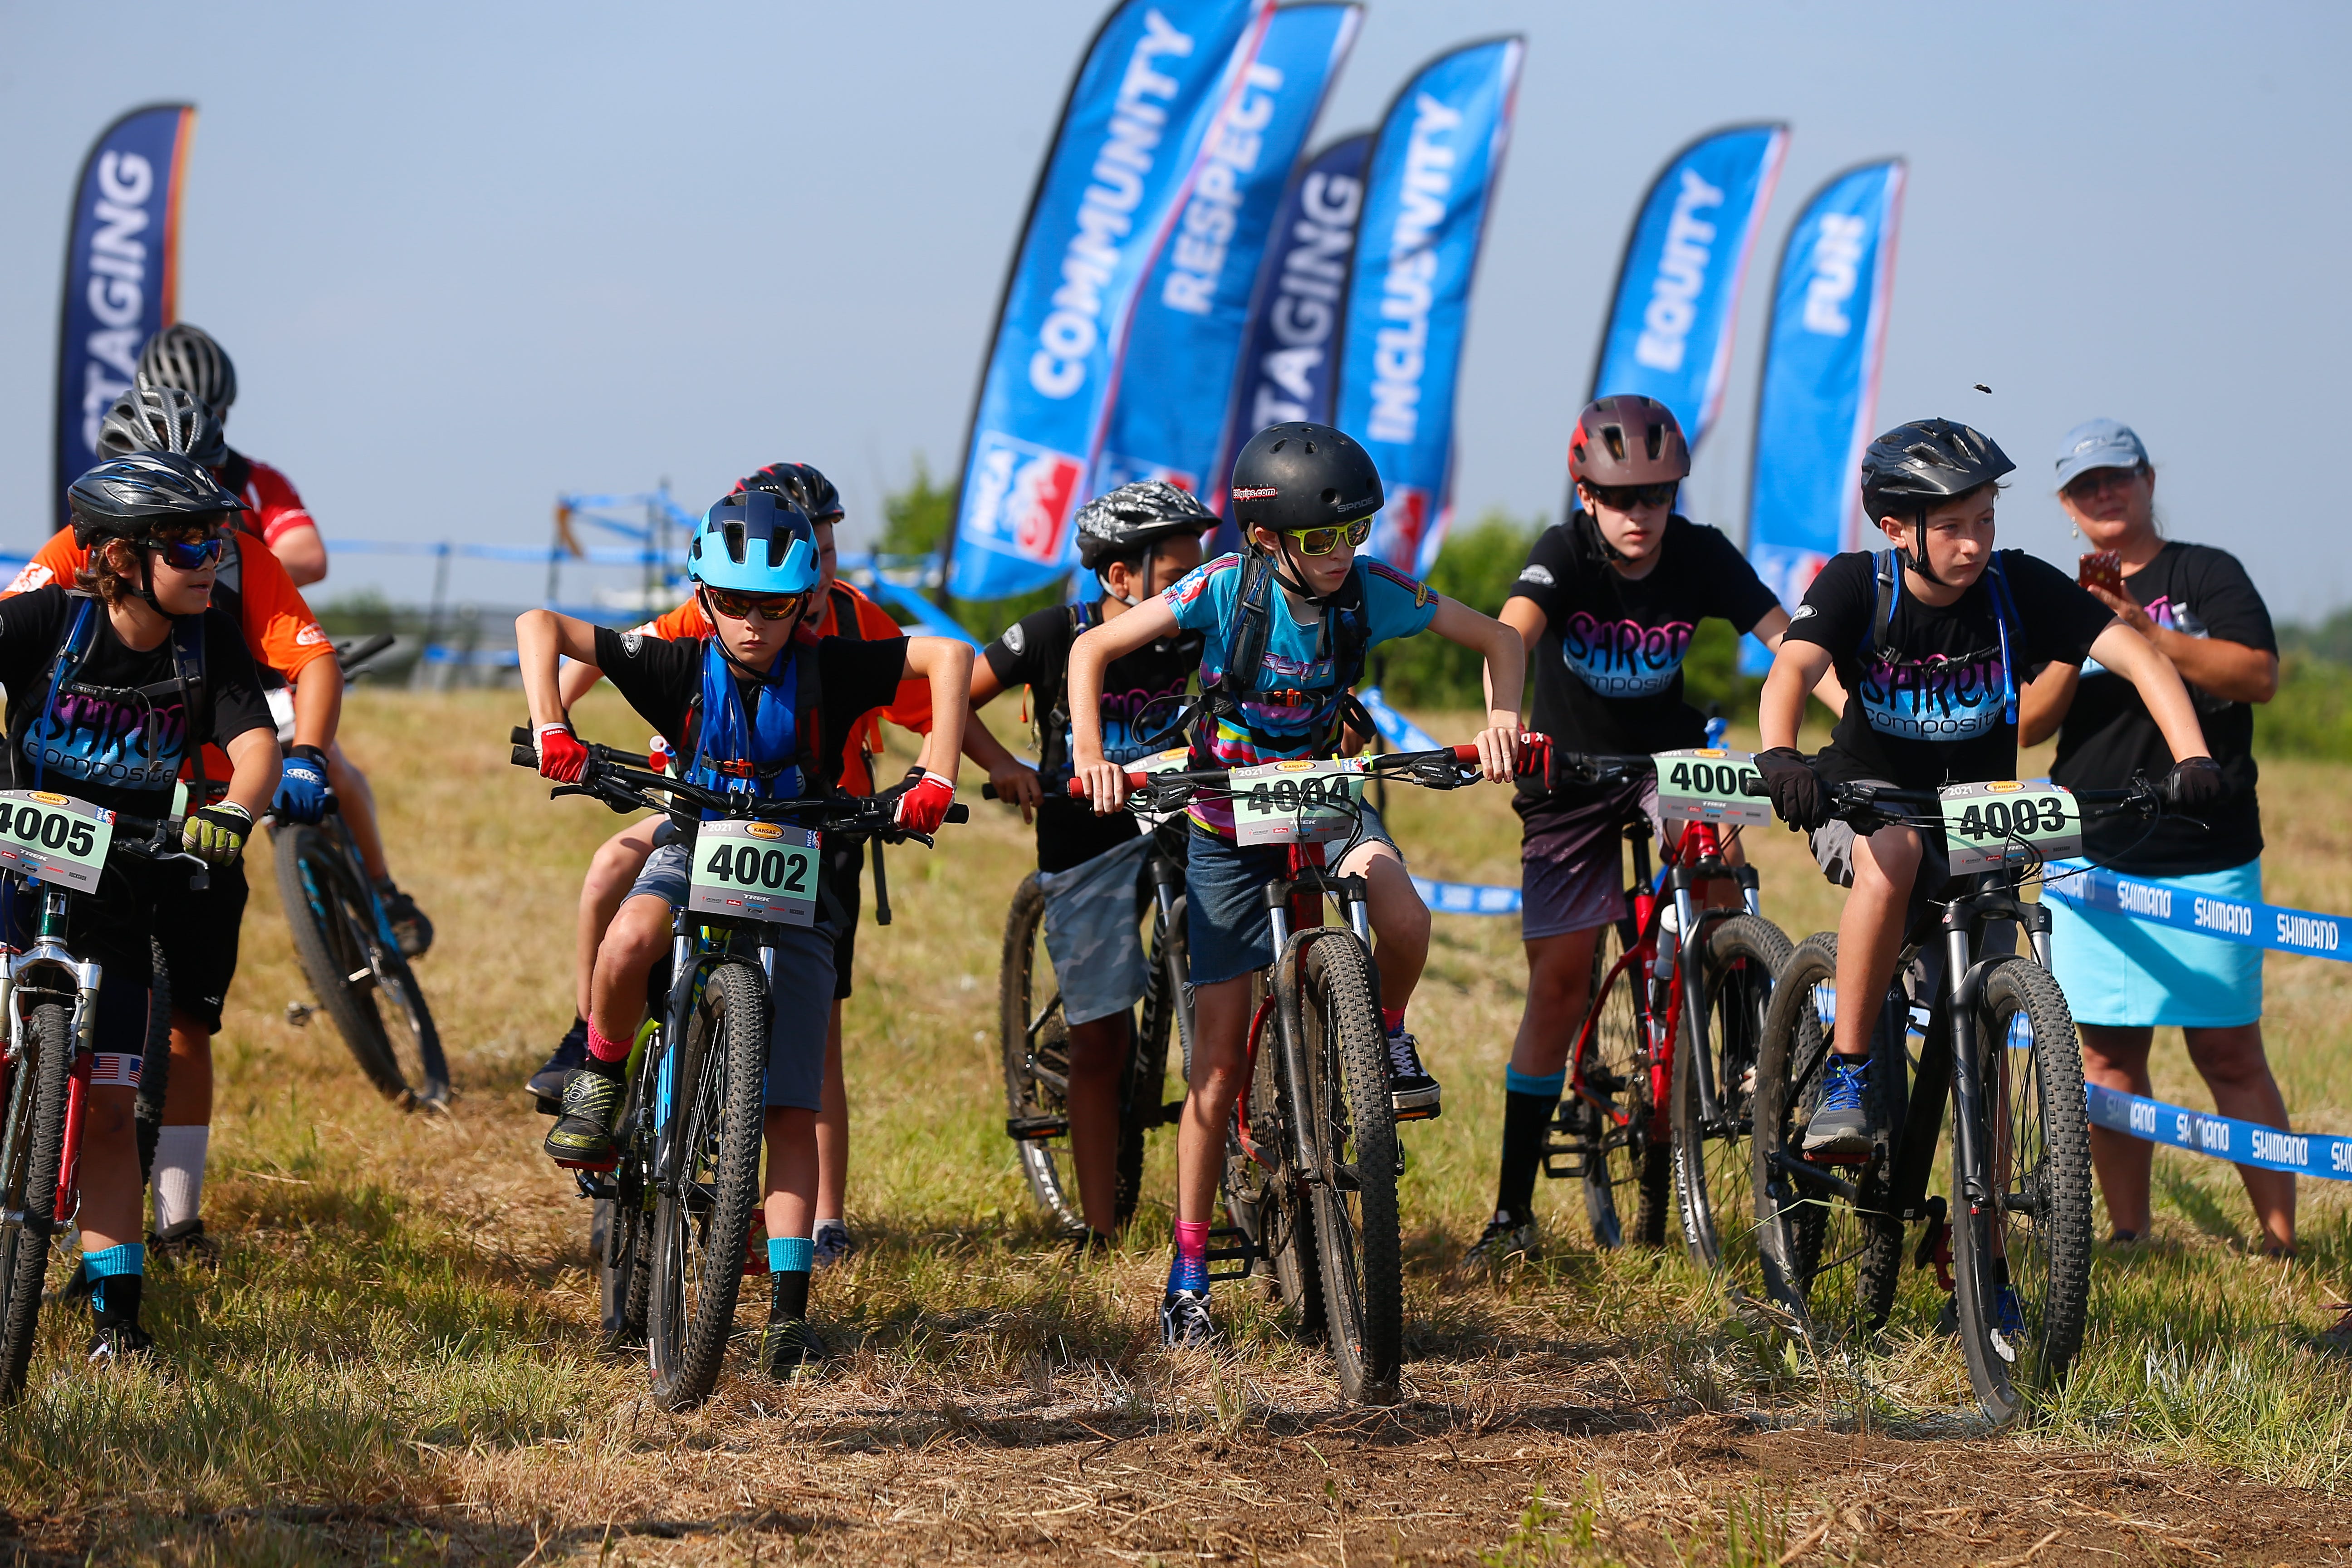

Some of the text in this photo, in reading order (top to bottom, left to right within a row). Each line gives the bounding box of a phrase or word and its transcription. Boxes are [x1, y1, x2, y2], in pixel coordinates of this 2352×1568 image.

[1029, 9, 1193, 399] COMMUNITY
[1162, 60, 1284, 315] RESPECT
[1636, 169, 1723, 372] EQUITY
[1802, 212, 1865, 337] FUN
[1253, 171, 1361, 426] TAGING
[1337, 498, 1374, 512] SPADE
[1176, 570, 1200, 587] NICA
[1238, 768, 1263, 777] 2021
[1947, 785, 1973, 796] 2021
[36, 794, 60, 802] KANSAS
[96, 807, 104, 820] NICA
[707, 823, 732, 832] 2021
[1960, 797, 2065, 841] 4003
[19, 848, 49, 862] TREK
[706, 844, 808, 894] 4002
[743, 893, 771, 902] TREK
[2117, 880, 2172, 919] SHIMANO
[2194, 897, 2253, 936] SHIMANO
[2276, 913, 2339, 951] SHIMANO
[2252, 1129, 2309, 1166] SHIMANO
